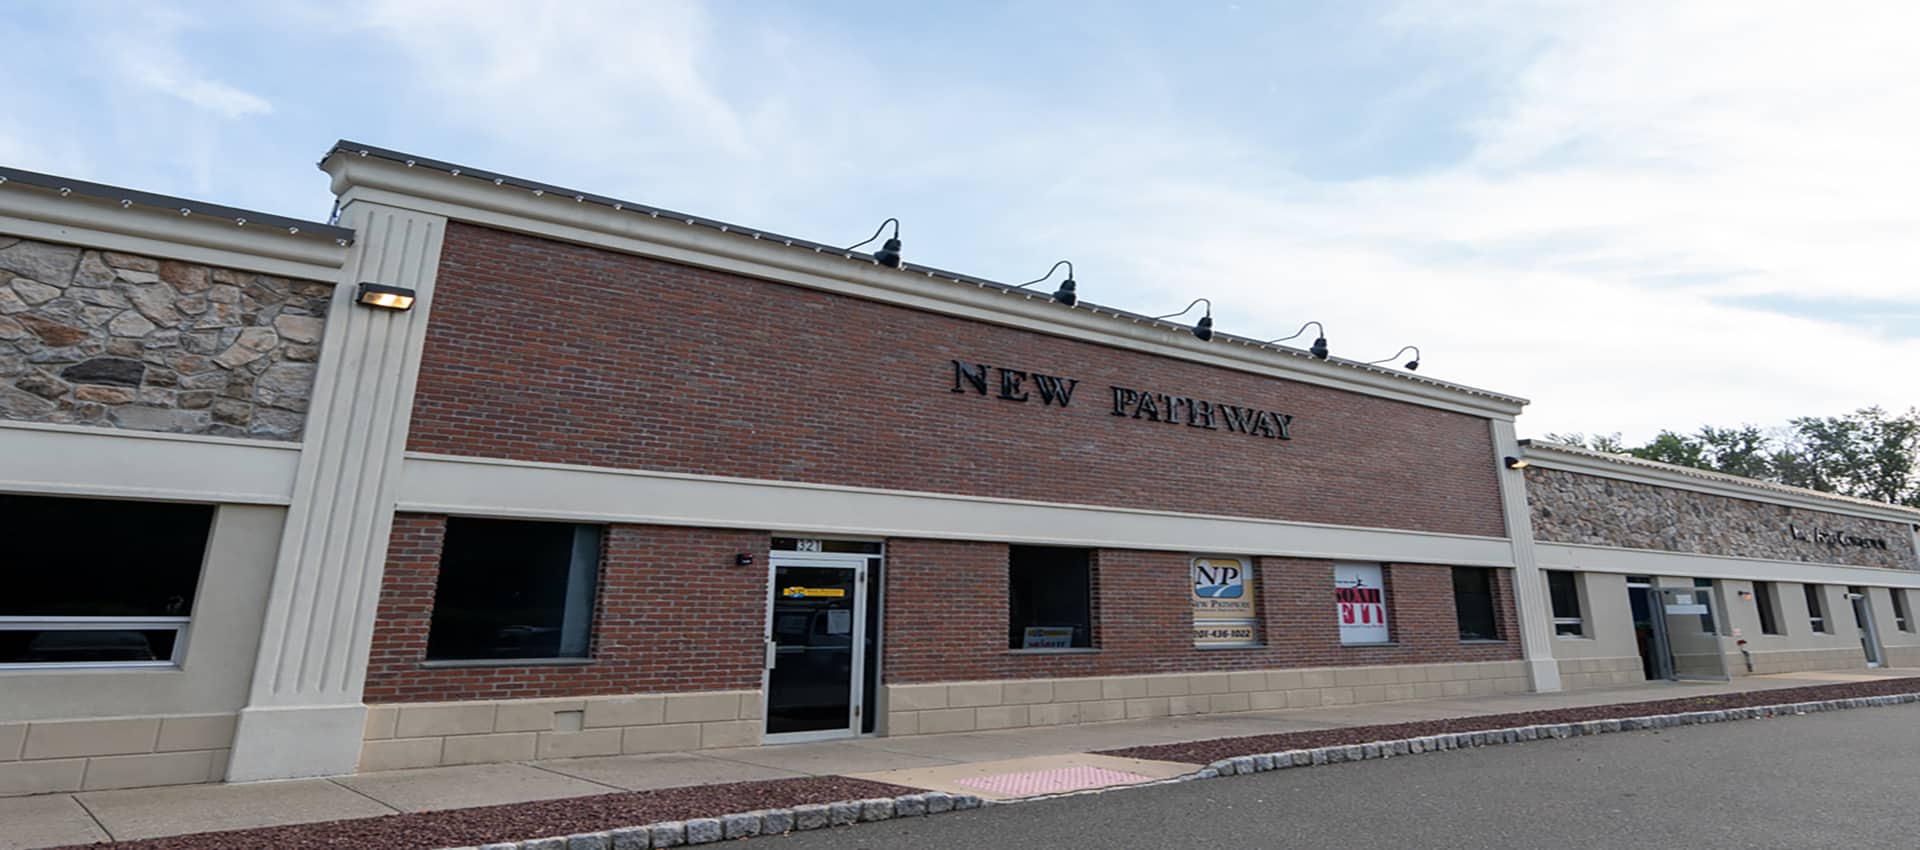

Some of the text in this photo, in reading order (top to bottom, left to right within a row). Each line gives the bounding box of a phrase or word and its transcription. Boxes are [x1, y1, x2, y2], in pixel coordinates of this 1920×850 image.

[951, 359, 1294, 440] NEW PATHWAY
[799, 539, 820, 552] 321
[1195, 565, 1238, 586] NP
